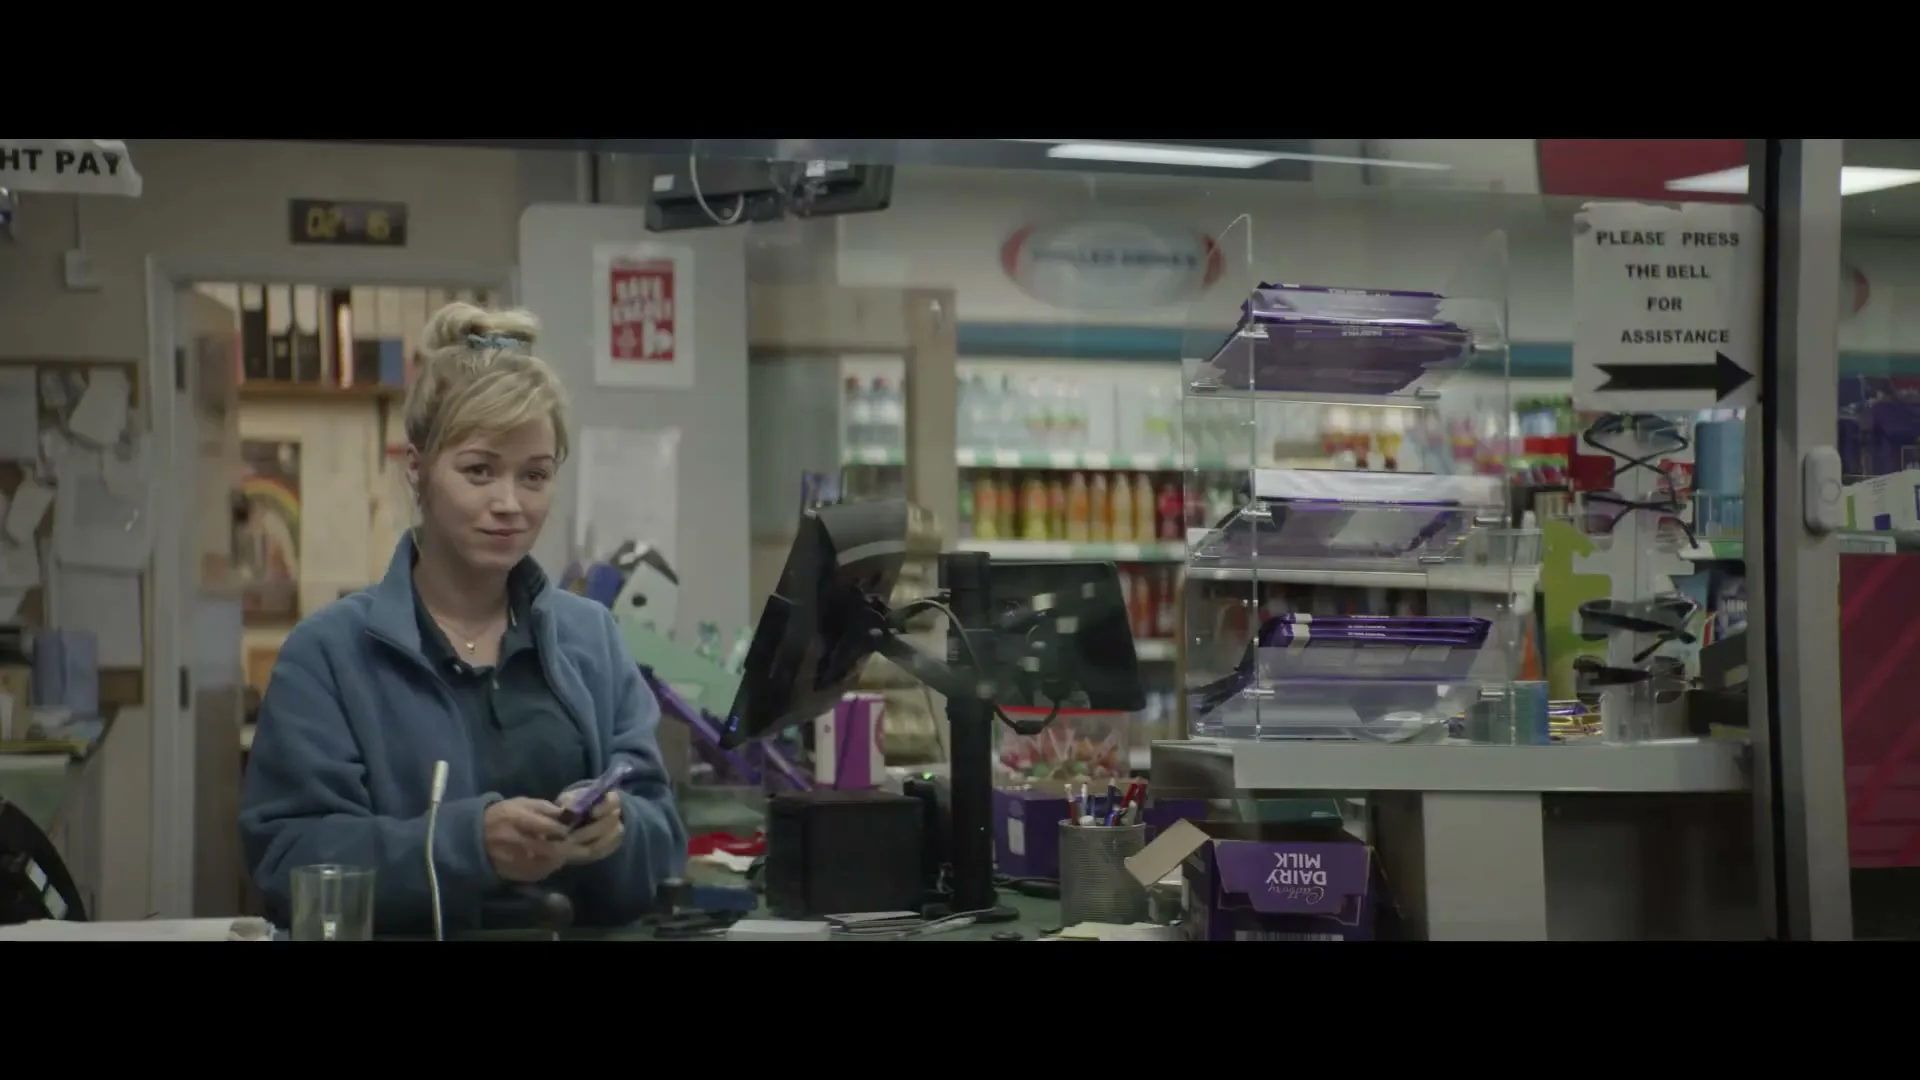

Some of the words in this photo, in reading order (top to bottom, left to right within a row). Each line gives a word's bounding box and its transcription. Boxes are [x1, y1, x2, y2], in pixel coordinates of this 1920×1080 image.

[0, 147, 43, 172] HT
[55, 149, 120, 175] PAY
[1596, 231, 1666, 246] PLEASE
[1681, 231, 1740, 247] PRESS
[1624, 264, 1661, 279] THE
[1667, 264, 1711, 279] BELL
[1646, 297, 1683, 312] FOR
[1620, 329, 1730, 345] ASSISTANCE
[1274, 852, 1321, 869] MILK
[1265, 868, 1327, 886] DAIRY
